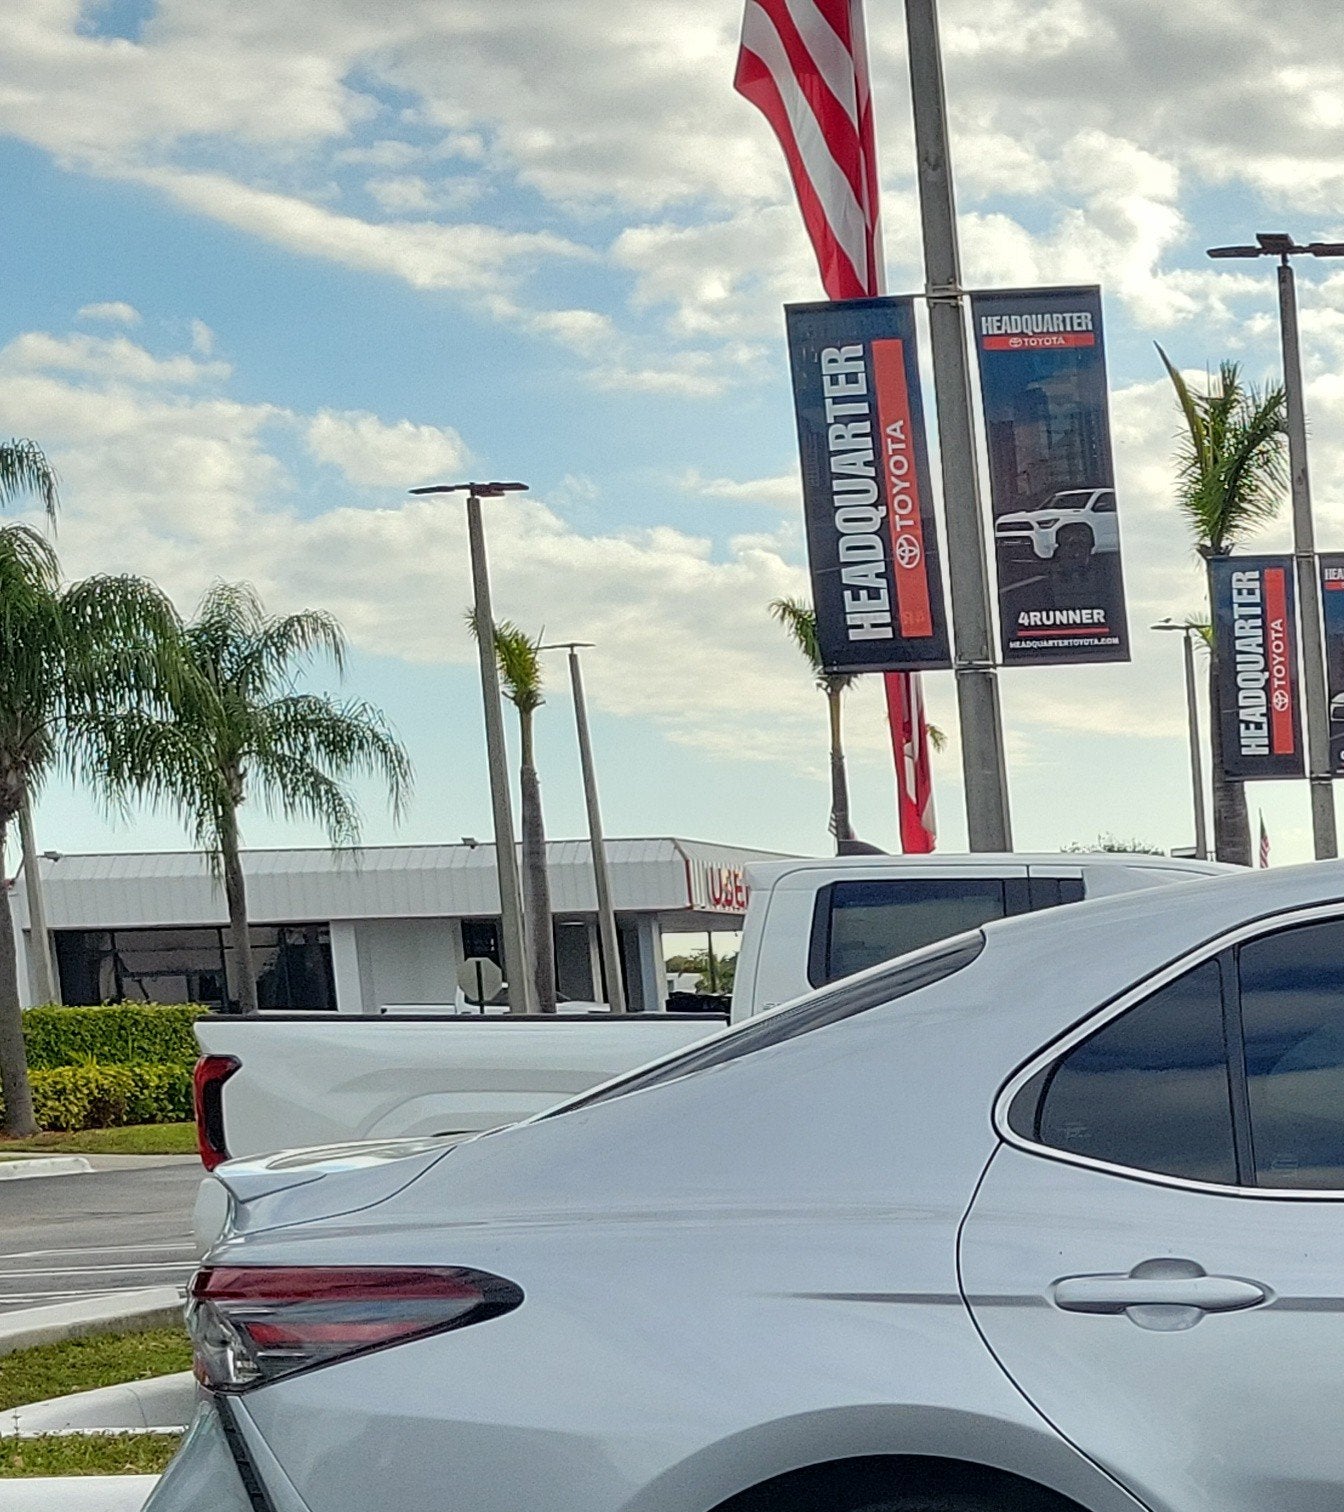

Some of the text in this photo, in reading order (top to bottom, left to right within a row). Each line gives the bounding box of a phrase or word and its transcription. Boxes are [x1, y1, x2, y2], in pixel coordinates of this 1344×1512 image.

[981, 312, 1093, 335] HEADQUARTER
[1024, 337, 1065, 346] TOYOTA
[821, 344, 893, 641] HEADQUARTER
[886, 419, 915, 531] TOYOTA
[1018, 609, 1106, 626] 4RUNNER
[1232, 570, 1269, 755] HEADQUARTER
[1271, 618, 1286, 688] TOYOTA
